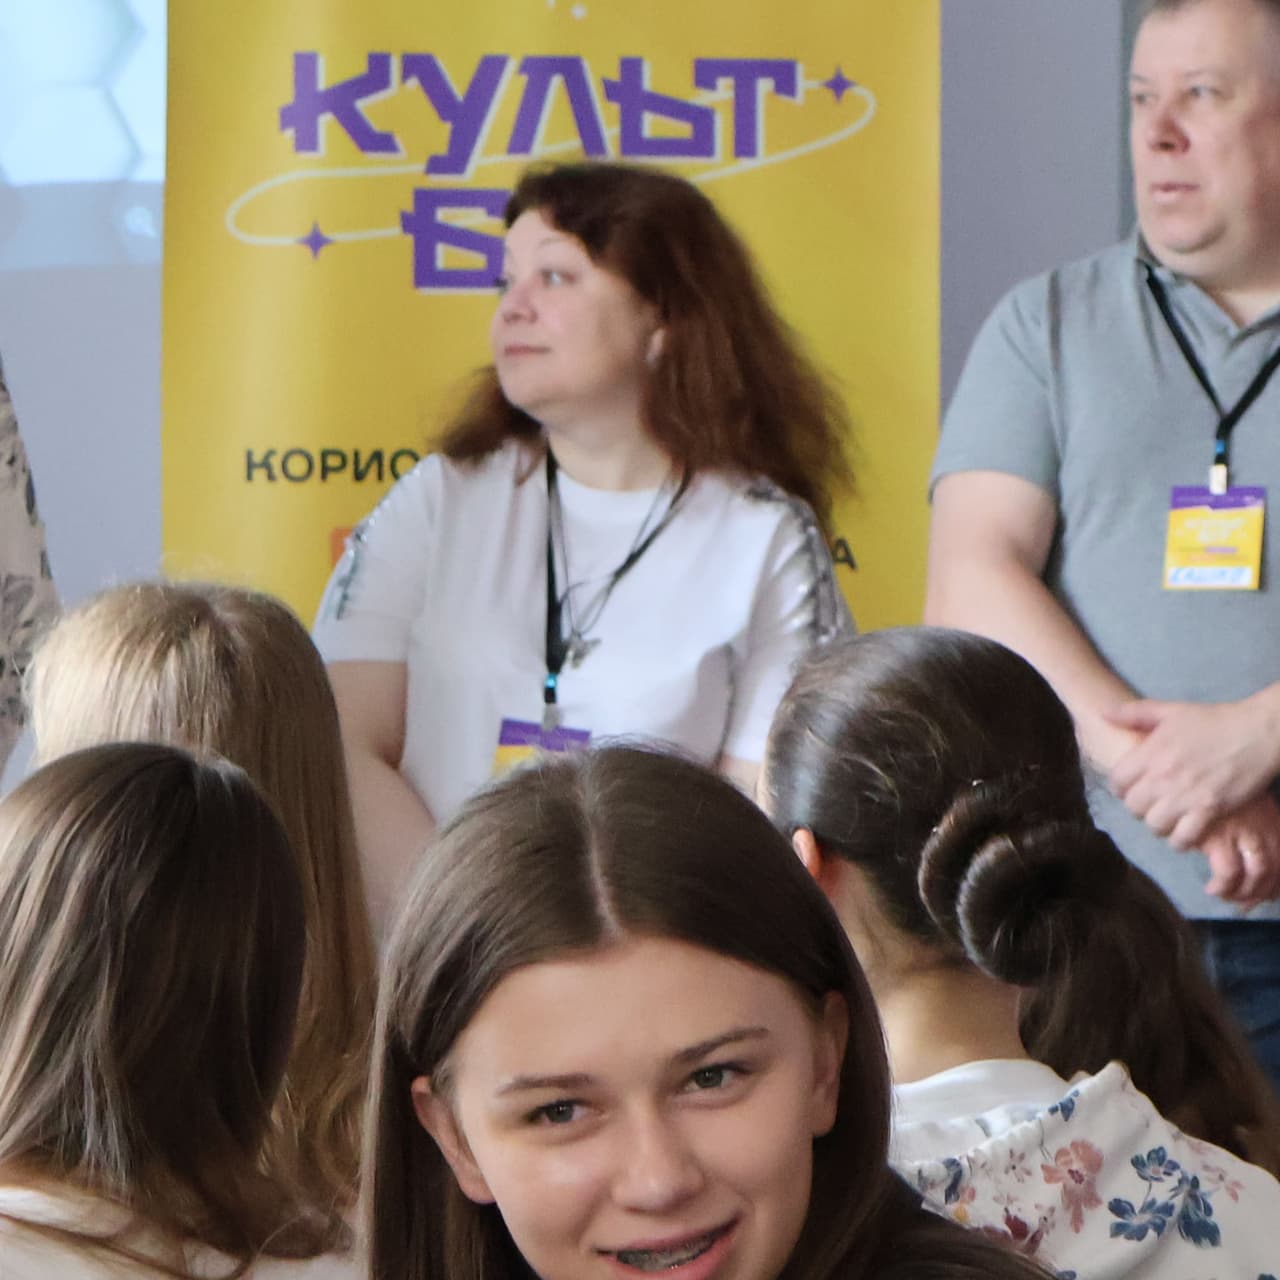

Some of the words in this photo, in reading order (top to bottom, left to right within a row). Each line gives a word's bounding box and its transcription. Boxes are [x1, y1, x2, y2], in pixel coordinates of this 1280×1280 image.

[280, 51, 802, 178] КУЛЬТ
[400, 187, 511, 292] Б
[246, 448, 420, 483] КОРИС
